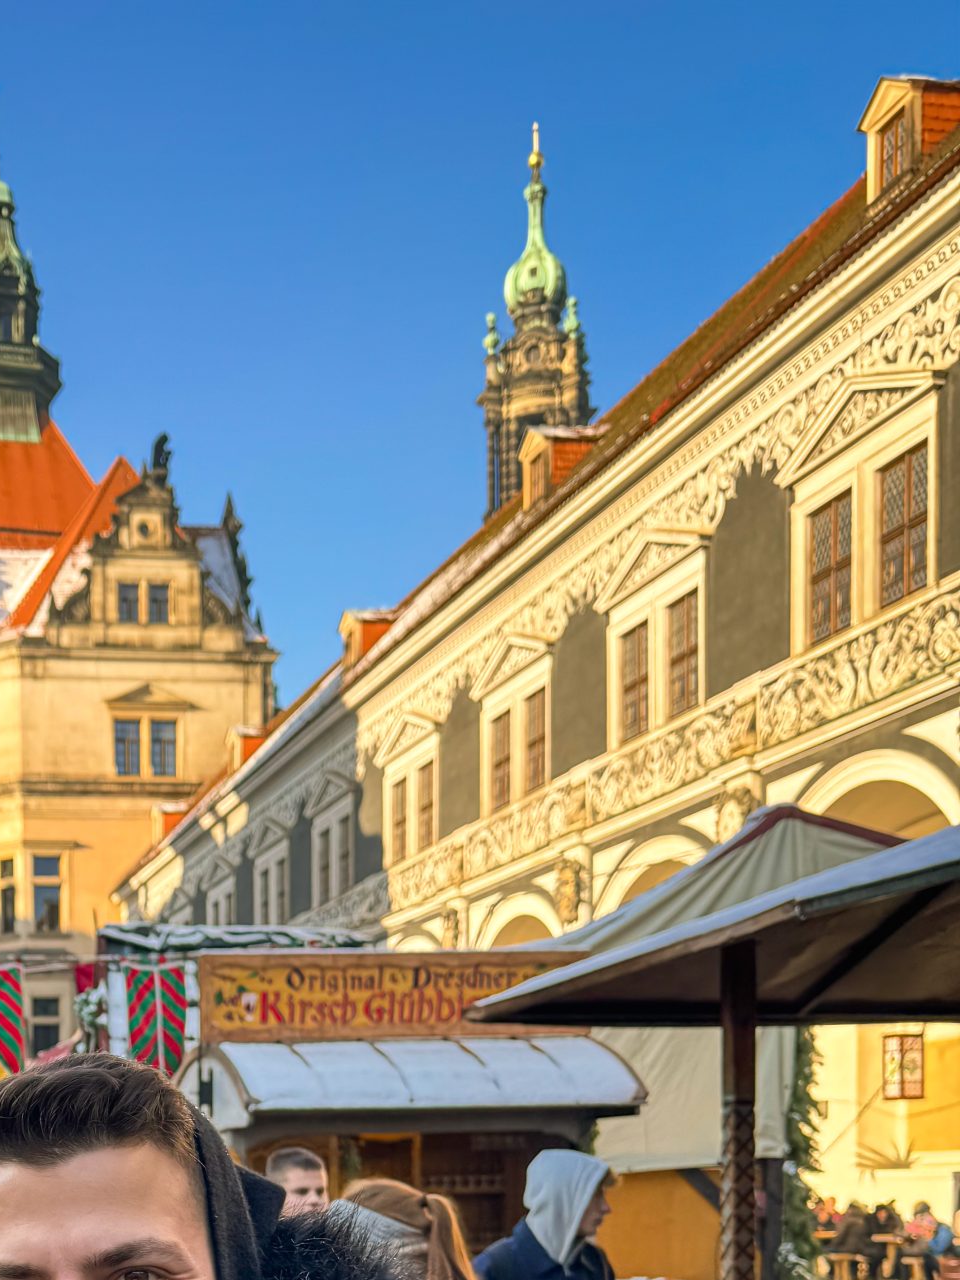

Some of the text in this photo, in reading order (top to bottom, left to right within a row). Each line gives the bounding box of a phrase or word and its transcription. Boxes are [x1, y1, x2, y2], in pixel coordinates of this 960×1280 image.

[286, 964, 515, 994] Original Dresdner
[259, 991, 356, 1025] Kirsch
